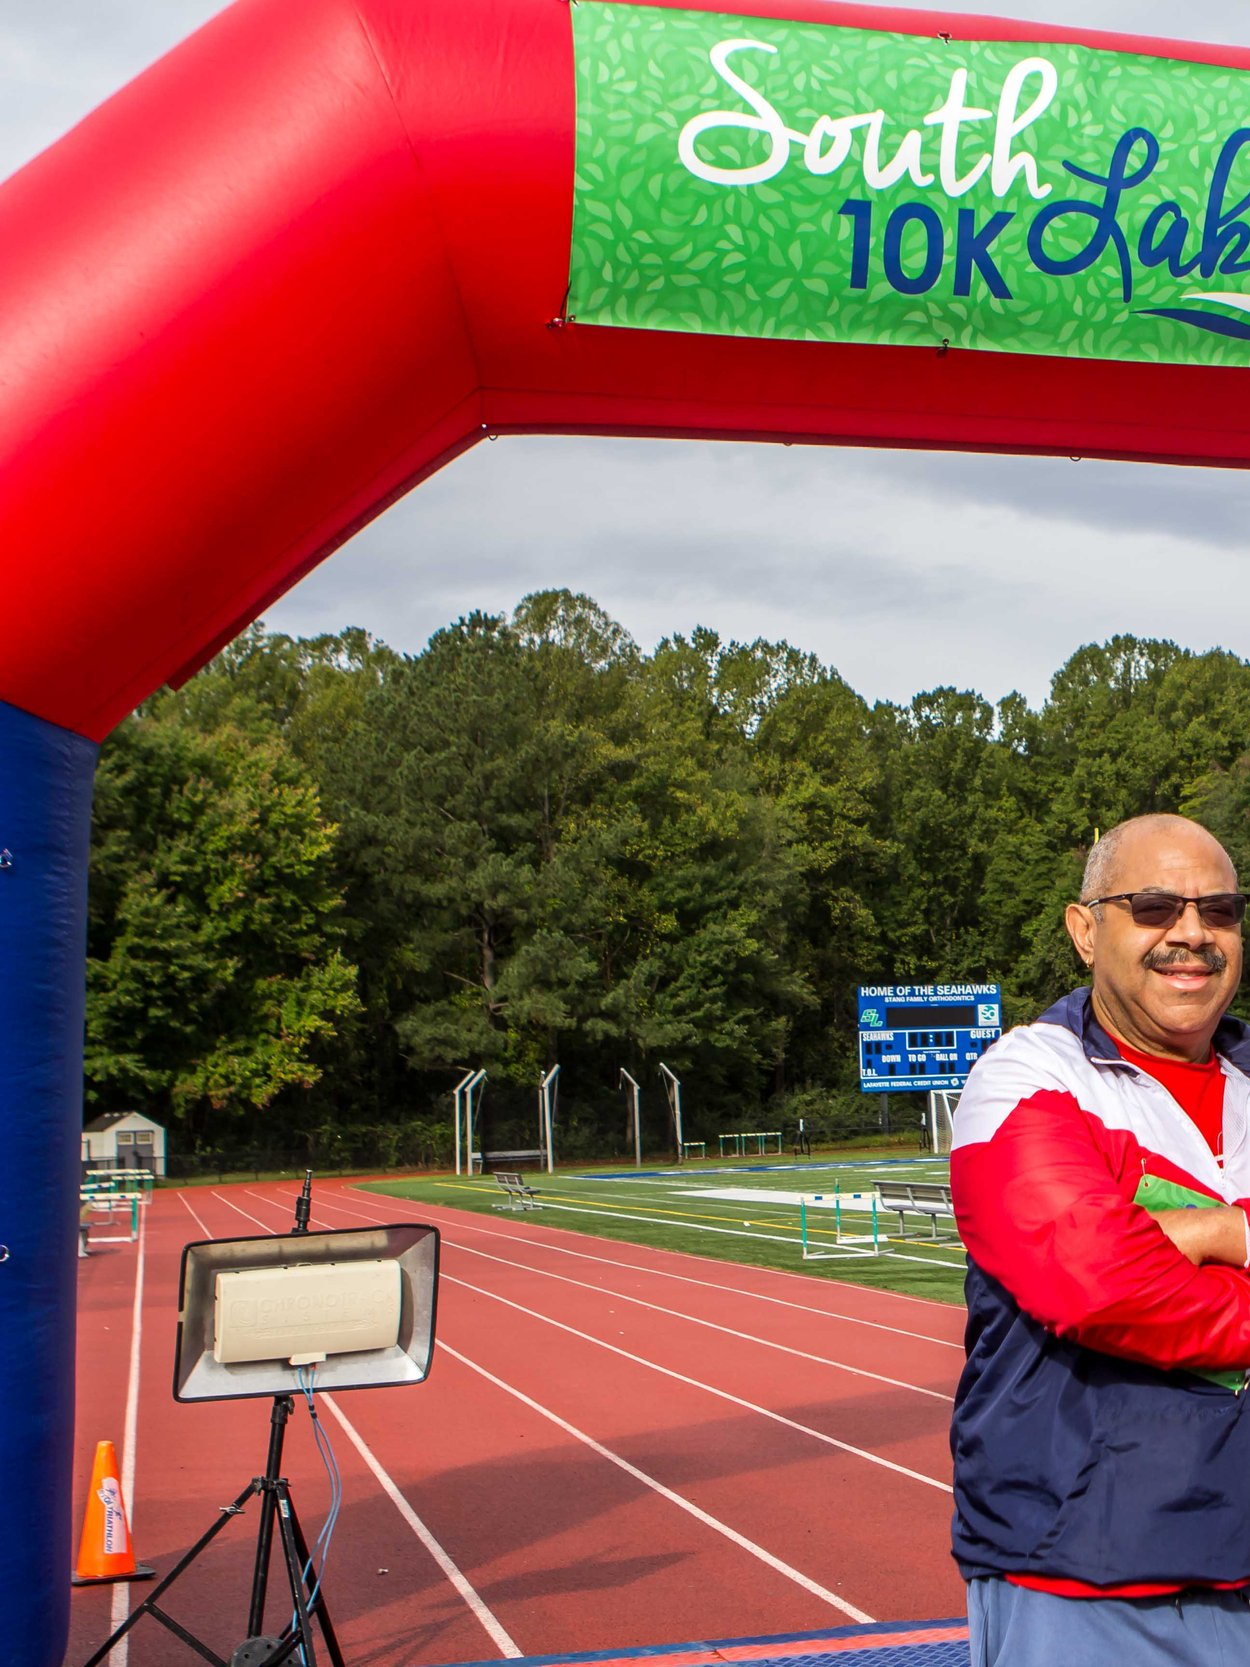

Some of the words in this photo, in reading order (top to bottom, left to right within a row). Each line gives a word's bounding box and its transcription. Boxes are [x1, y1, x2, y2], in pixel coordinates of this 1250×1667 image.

[678, 38, 1058, 198] South
[837, 198, 1016, 300] 10K
[861, 986, 894, 997] HOME
[896, 986, 911, 996] OF
[913, 985, 934, 996] THE
[936, 984, 997, 995] SEAHAWKS
[863, 1032, 894, 1041] SEAHAWKS
[970, 1030, 995, 1039] GUEST
[882, 1055, 901, 1063] DOWN
[908, 1054, 917, 1062] TO
[917, 1054, 926, 1062] GO
[935, 1053, 949, 1061] BALL
